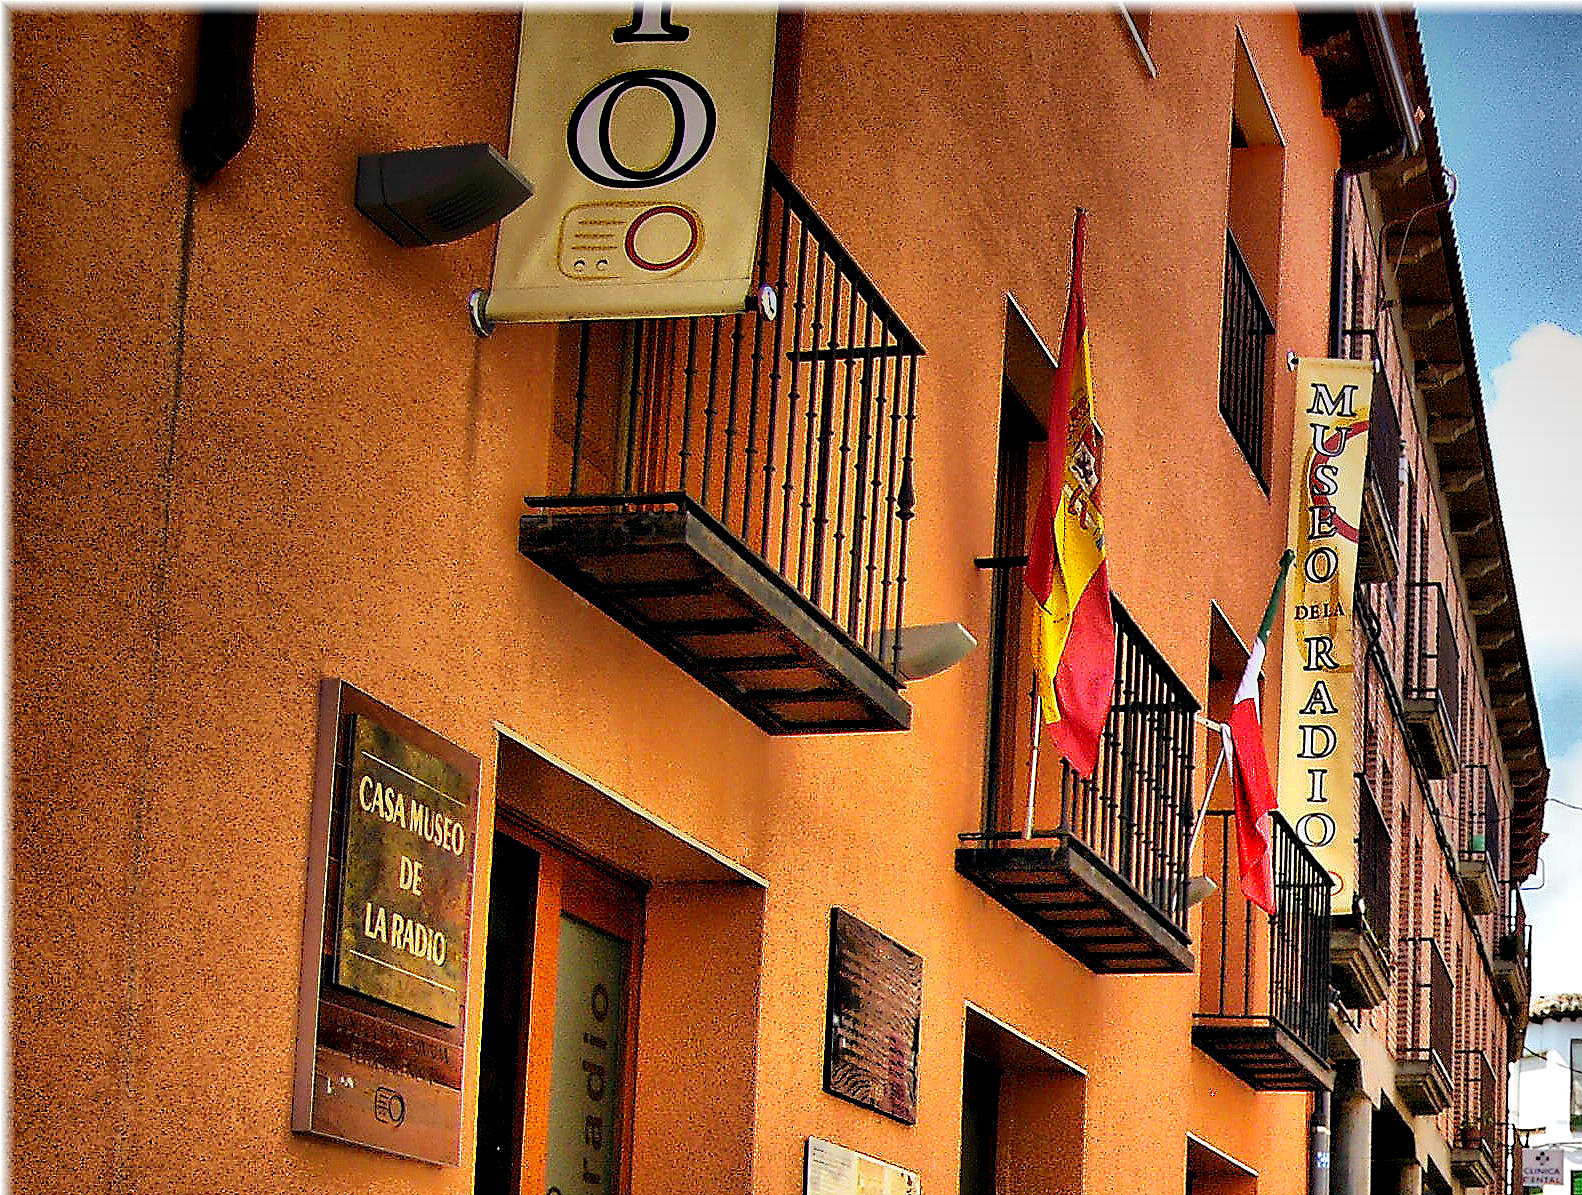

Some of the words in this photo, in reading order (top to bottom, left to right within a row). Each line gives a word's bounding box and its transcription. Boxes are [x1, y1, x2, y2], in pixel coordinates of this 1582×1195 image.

[1306, 383, 1359, 584] MUSEO
[1295, 636, 1340, 848] RADIO
[359, 775, 406, 829] CASA
[409, 799, 465, 857] MUSEO
[399, 855, 424, 896] DE
[364, 902, 387, 943] LA
[391, 912, 447, 967] RADIO
[582, 983, 610, 1186] radio
